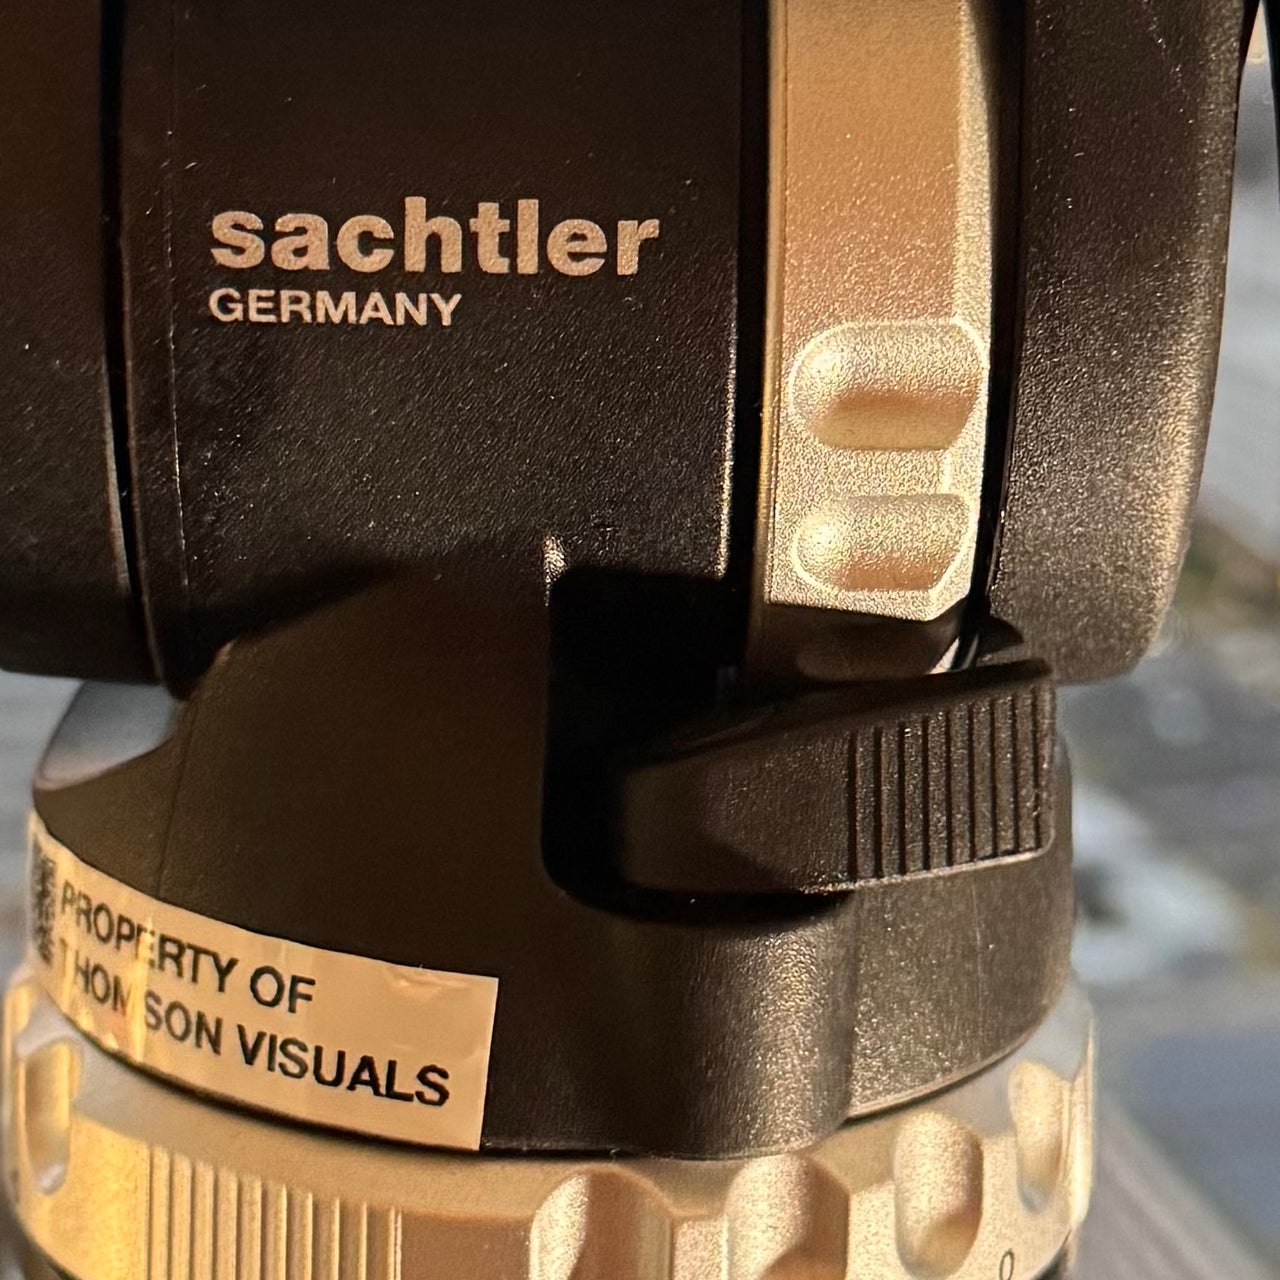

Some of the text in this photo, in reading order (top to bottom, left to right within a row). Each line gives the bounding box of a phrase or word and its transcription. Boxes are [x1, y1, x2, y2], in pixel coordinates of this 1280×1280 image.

[210, 196, 660, 276] sachtler
[209, 287, 462, 326] GERMANY
[61, 880, 317, 1014] PROPERTY OF
[236, 1023, 451, 1108] VISUALS
